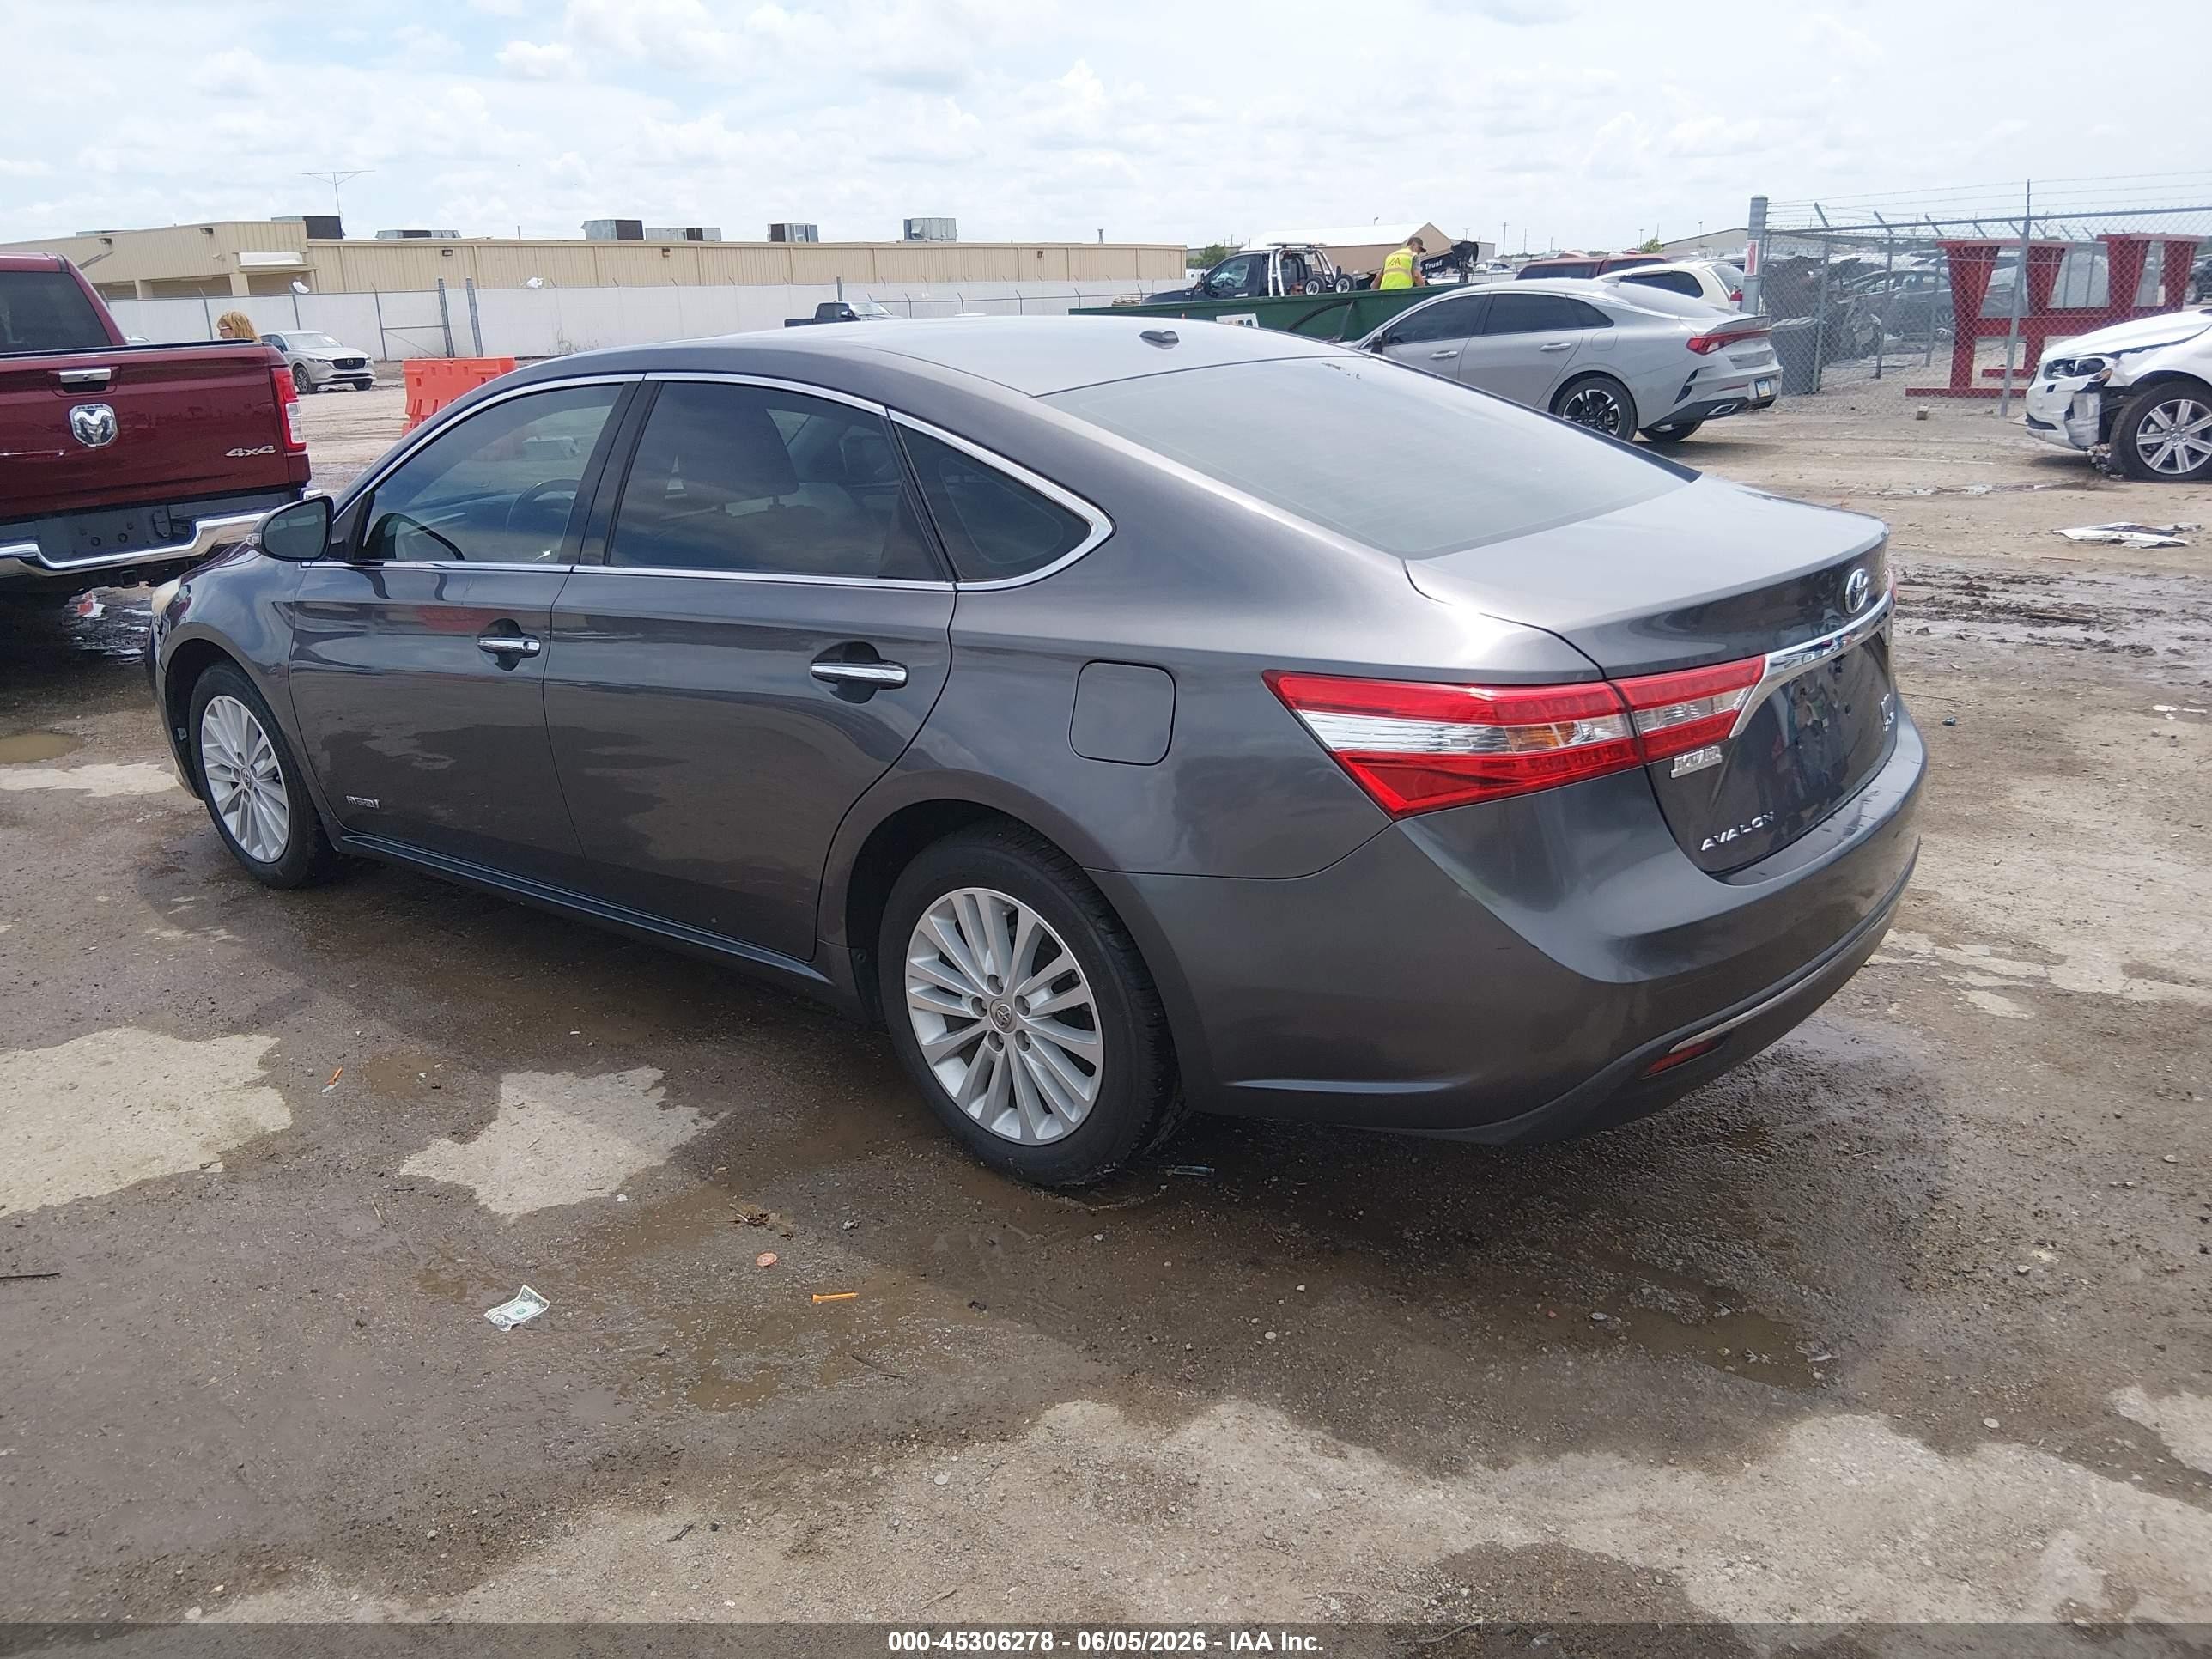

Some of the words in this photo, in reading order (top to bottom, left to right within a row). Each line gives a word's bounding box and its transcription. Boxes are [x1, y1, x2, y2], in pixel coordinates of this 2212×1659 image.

[1425, 259, 1443, 270] Trust
[224, 445, 276, 457] 4x4
[1700, 811, 1775, 851] AVALON
